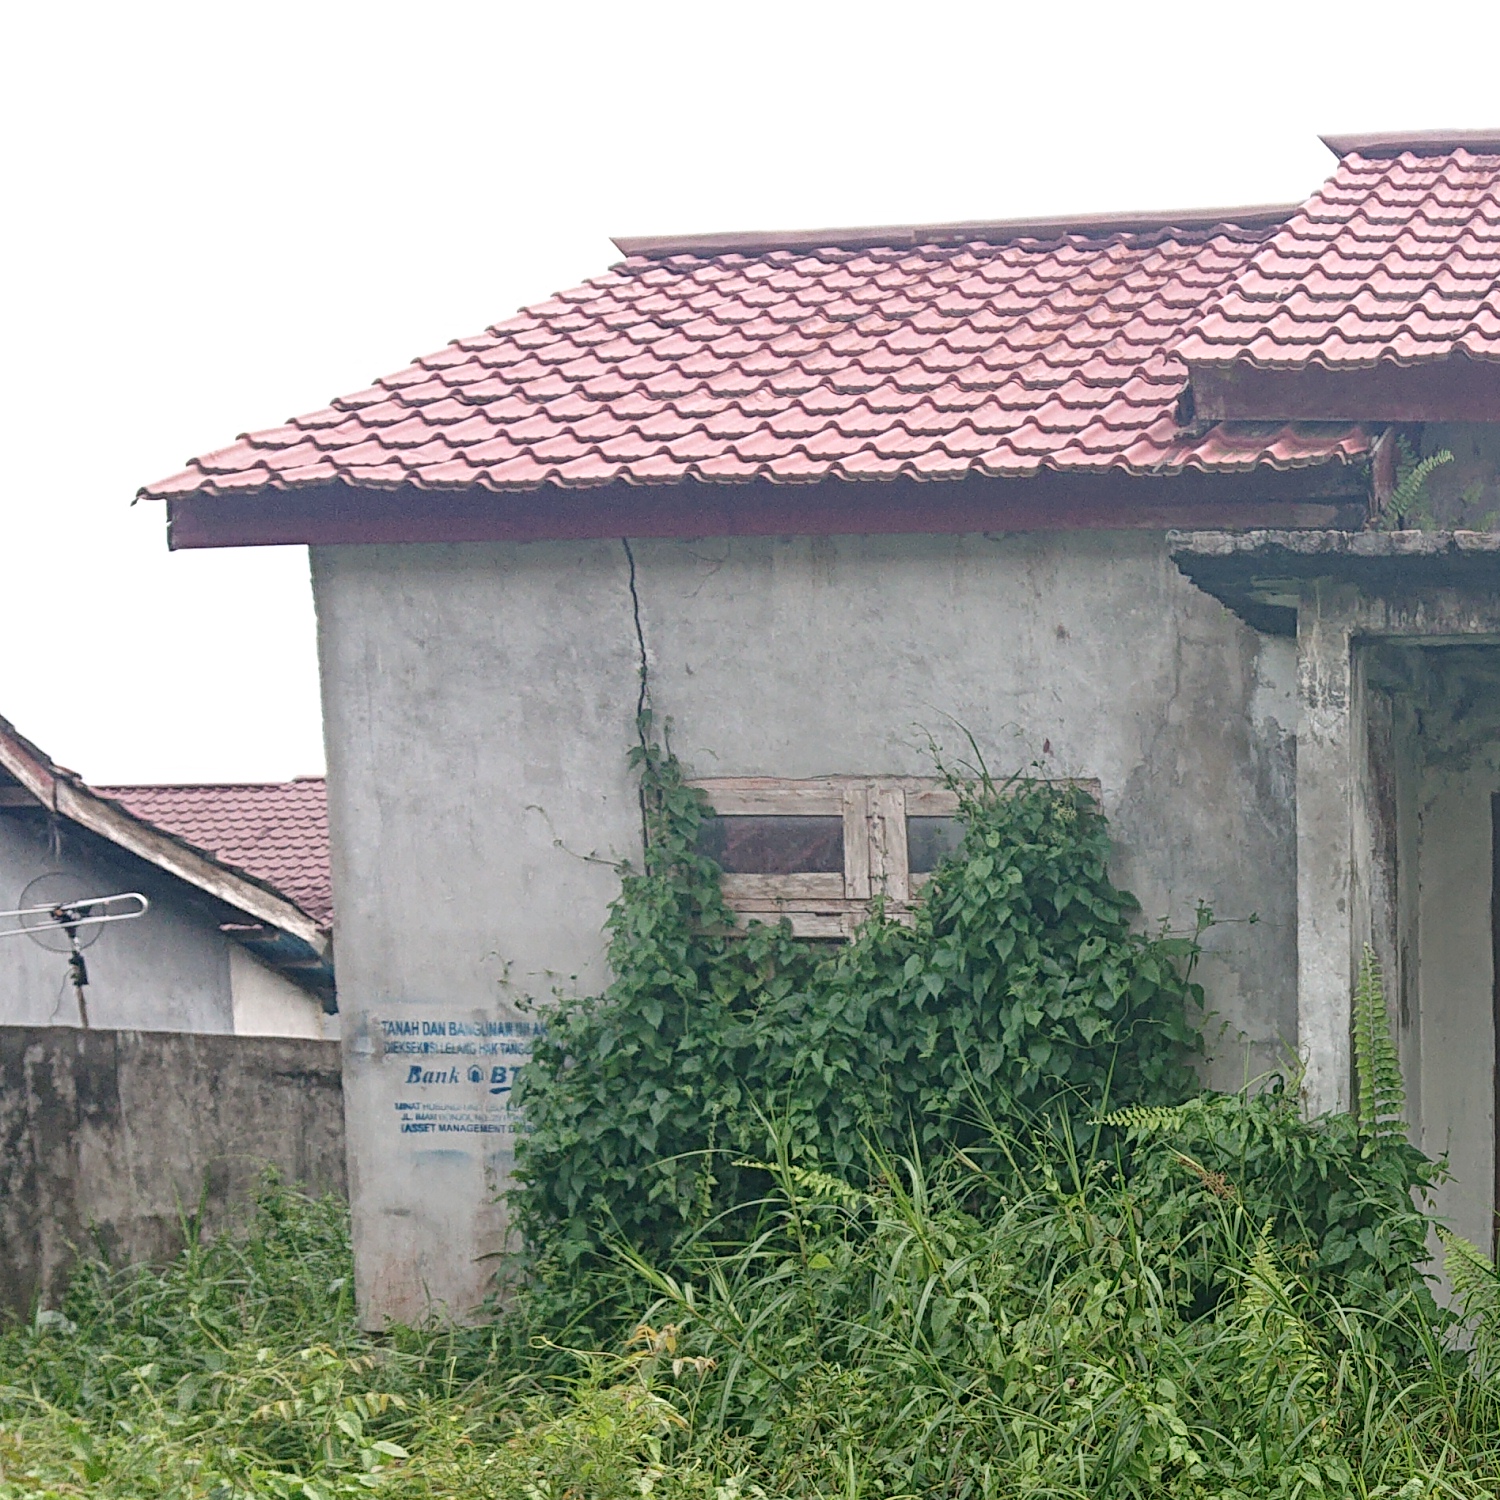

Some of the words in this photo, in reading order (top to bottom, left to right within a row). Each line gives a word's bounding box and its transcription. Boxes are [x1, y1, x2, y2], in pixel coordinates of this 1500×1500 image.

[381, 1021, 419, 1036] TANAH
[422, 1021, 446, 1036] DAN
[405, 1065, 460, 1084] Bank
[438, 1123, 506, 1133] MANAGEMENT
